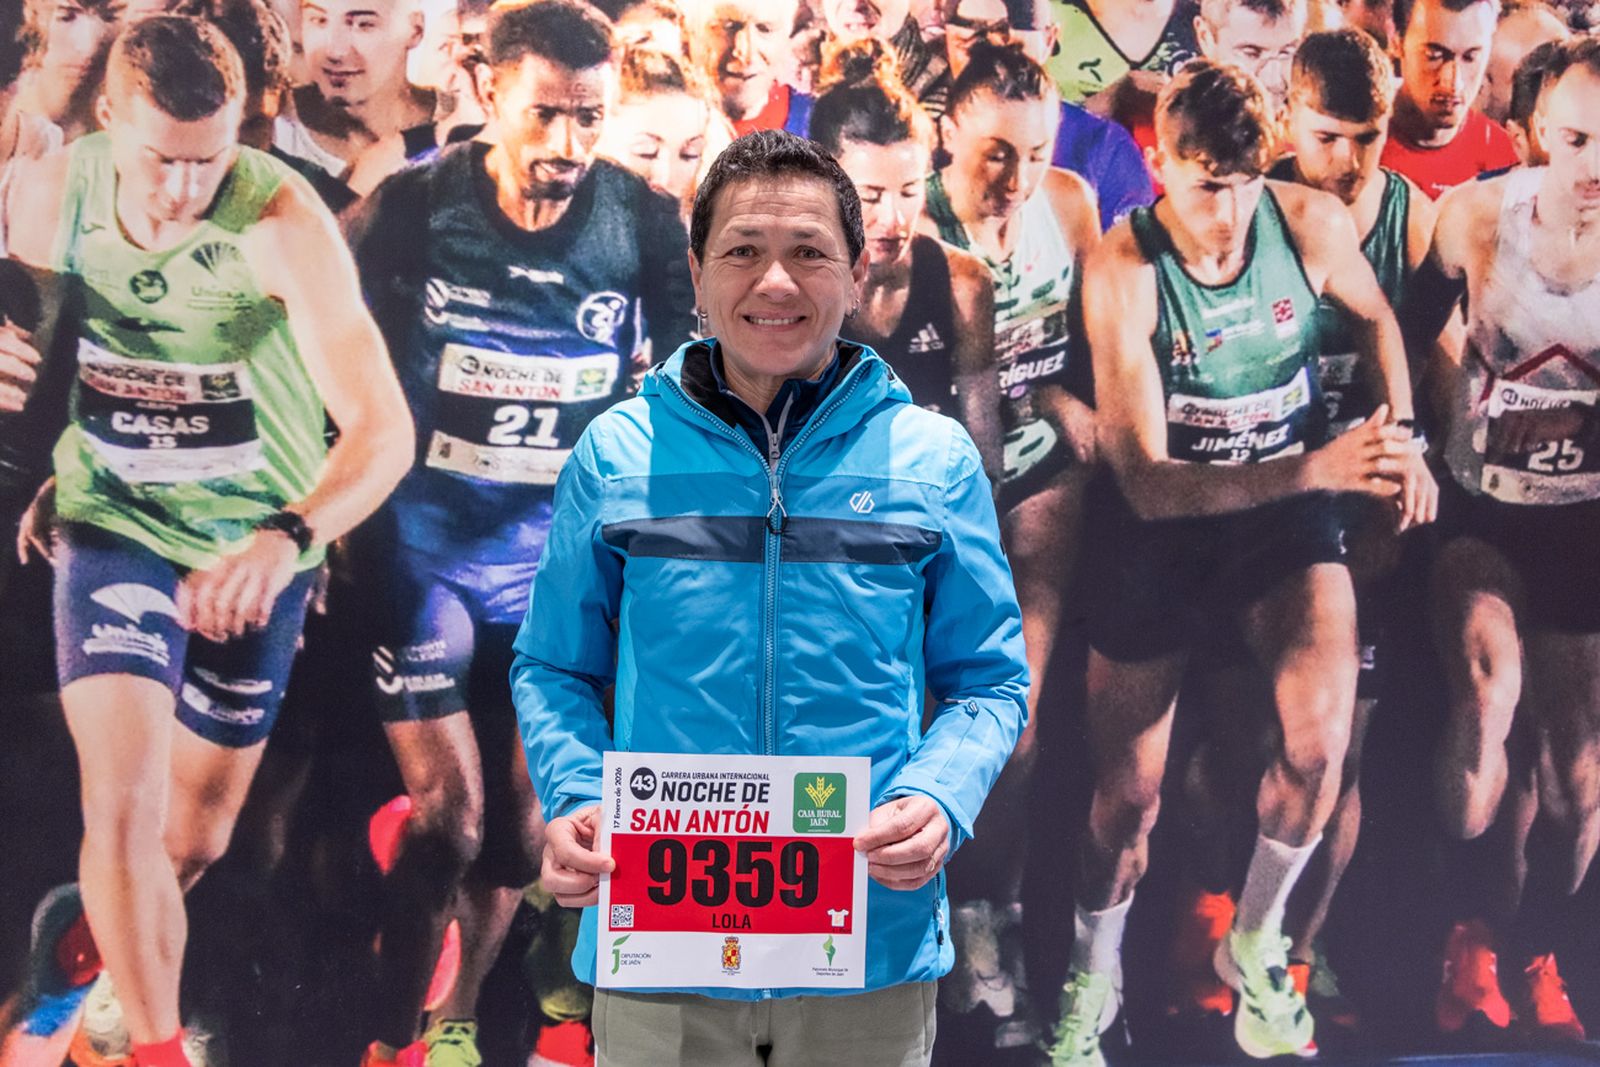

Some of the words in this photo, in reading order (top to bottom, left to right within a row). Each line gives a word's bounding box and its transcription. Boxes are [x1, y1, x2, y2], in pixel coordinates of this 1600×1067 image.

[111, 411, 210, 435] CASAS
[487, 405, 560, 448] 21
[1191, 423, 1290, 453] JIMÉNEZ
[1528, 438, 1583, 472] 25
[631, 774, 656, 792] 43
[661, 771, 691, 780] CARRERA
[692, 772, 719, 780] URBANA
[719, 772, 770, 781] INTERNACIONAL
[615, 787, 622, 797] de
[661, 780, 737, 803] NOCHE
[741, 782, 771, 804] DE
[629, 808, 682, 832] SAN
[685, 803, 770, 834] ANTÓN
[797, 809, 815, 818] CAJA
[816, 809, 842, 818] RURAL
[613, 820, 620, 829] 17
[647, 838, 820, 909] 9359
[711, 912, 752, 930] LOLA
[620, 952, 652, 960] DIPUTACIÓN
